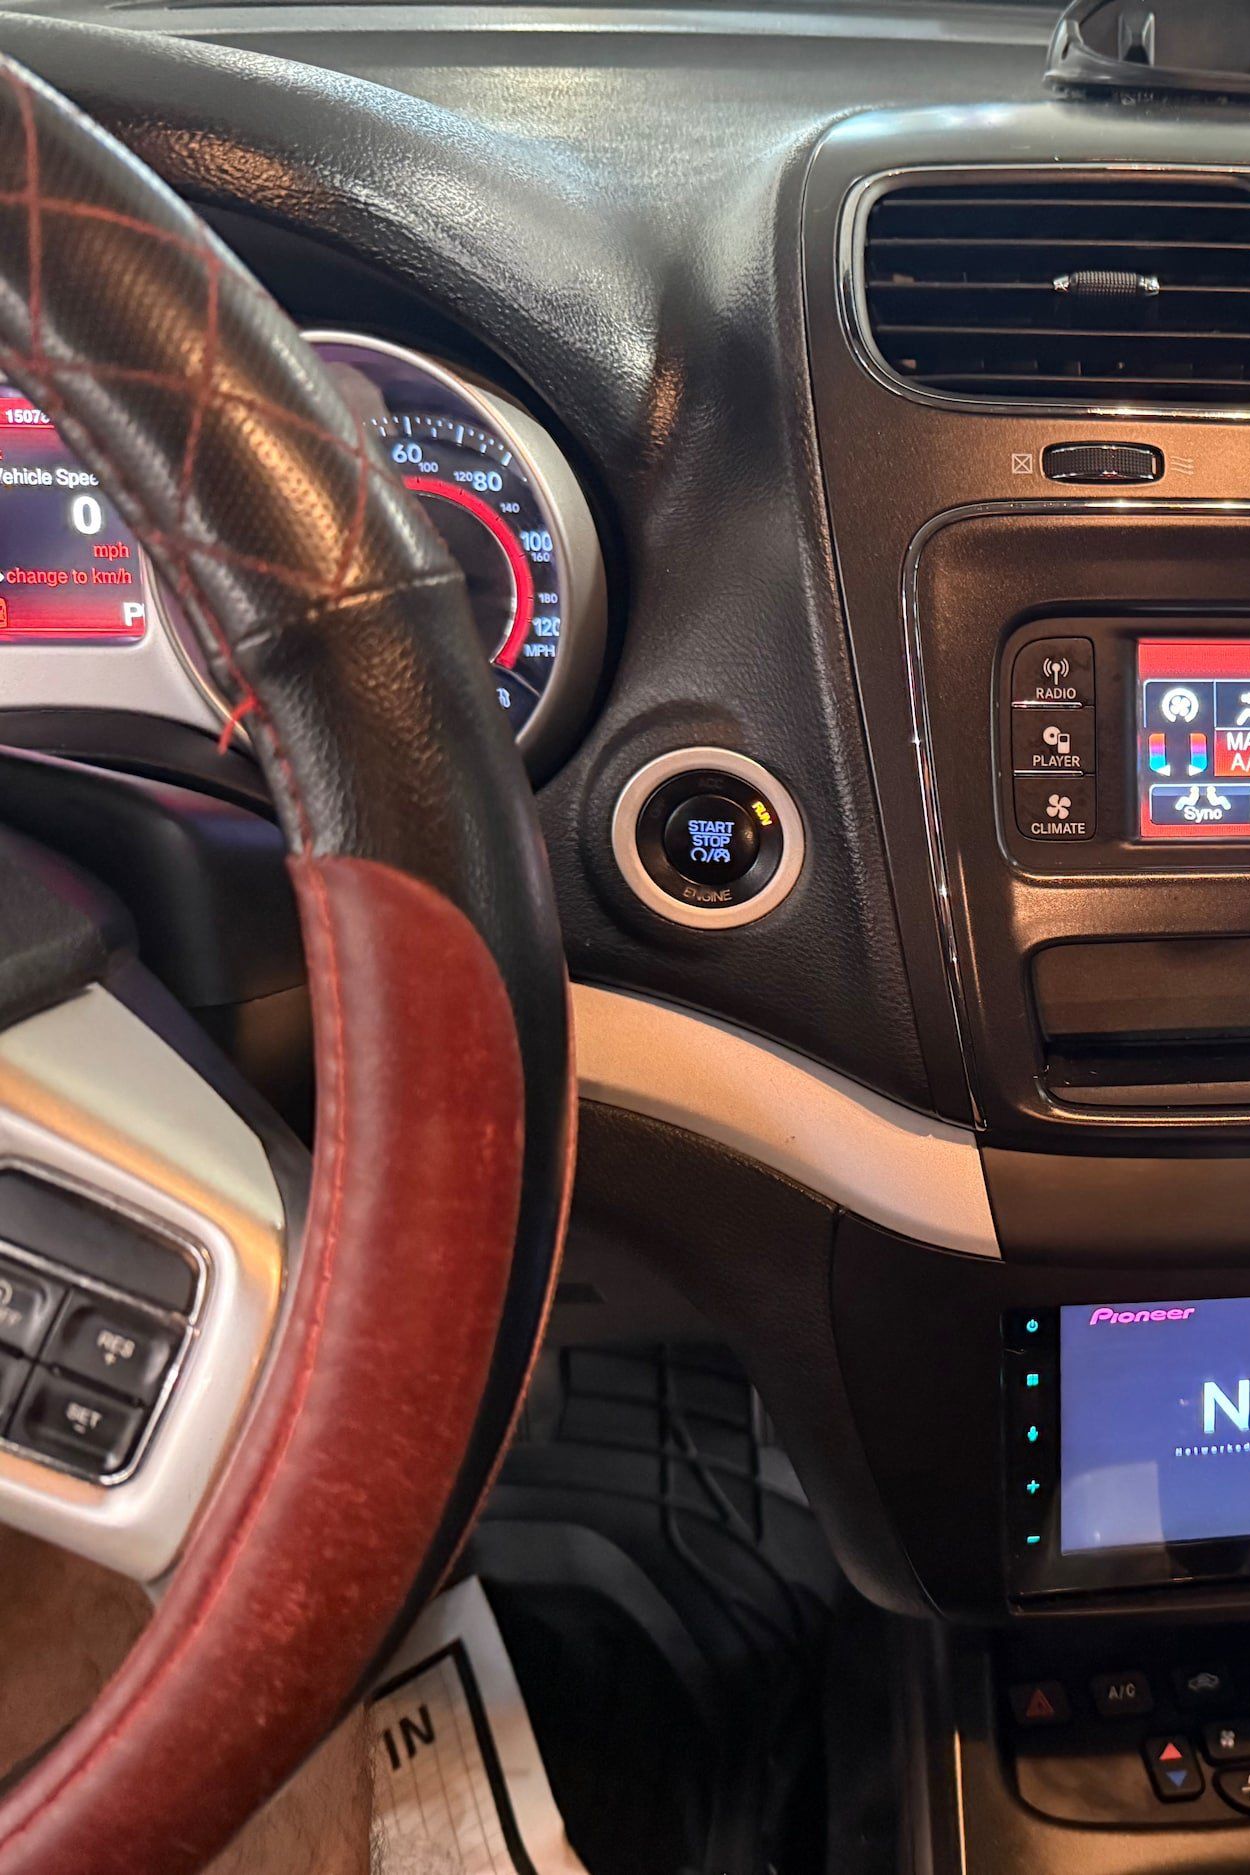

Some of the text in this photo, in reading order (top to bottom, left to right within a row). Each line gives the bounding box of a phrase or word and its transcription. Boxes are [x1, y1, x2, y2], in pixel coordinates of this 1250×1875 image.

[392, 443, 423, 464] 60
[418, 461, 439, 474] 100
[453, 471, 473, 483] 120
[472, 471, 503, 492] 80
[72, 495, 103, 535] 0
[500, 502, 520, 514] 140
[520, 531, 553, 552] 100
[93, 542, 130, 560] mph
[531, 552, 550, 563] 160
[6, 567, 133, 587] change to km/h
[538, 593, 558, 604] 180
[123, 602, 145, 627] P
[532, 618, 561, 637] 120
[524, 644, 556, 658] MPH
[1035, 687, 1077, 700] RADIO
[1032, 755, 1081, 768] PLAYER
[751, 801, 773, 827] RUN
[1183, 806, 1223, 823] Sync
[688, 819, 735, 834] START
[1031, 822, 1086, 835] CLIMATE
[692, 835, 731, 848] STOP
[682, 887, 734, 903] ENGINE
[1089, 1306, 1196, 1326] Pioneer
[1108, 1683, 1136, 1700] A/C
